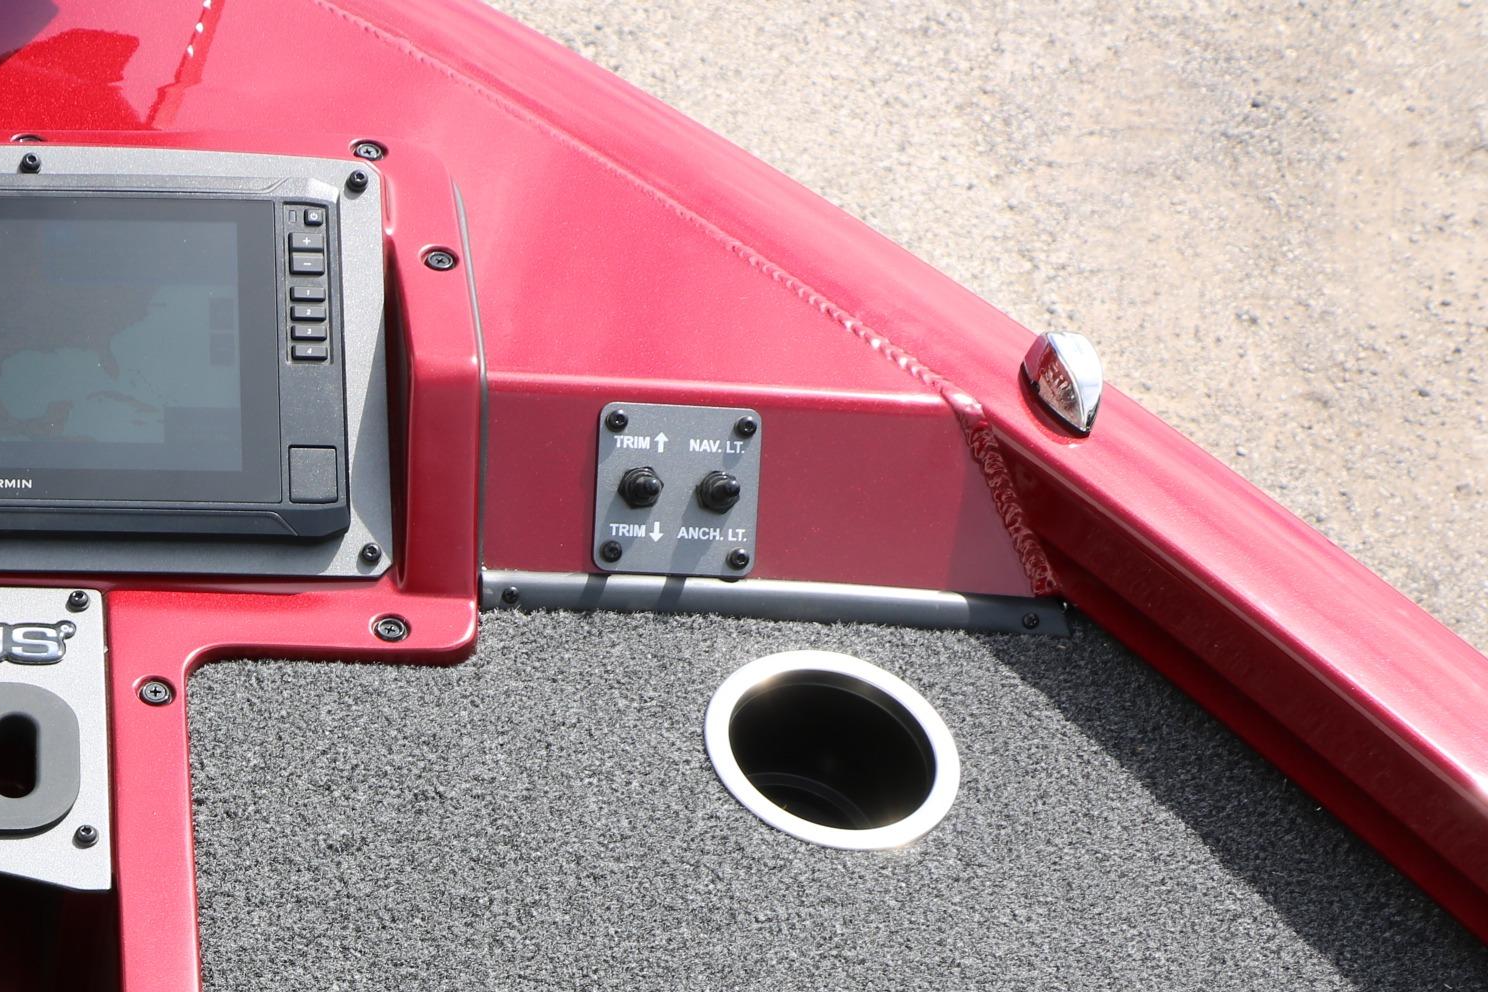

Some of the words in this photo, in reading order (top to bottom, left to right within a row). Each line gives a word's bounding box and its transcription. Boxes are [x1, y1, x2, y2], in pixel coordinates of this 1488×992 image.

[614, 435, 651, 450] TRIM
[689, 439, 722, 453] NAV.
[726, 441, 745, 454] LT.
[609, 523, 646, 537] TRIM
[677, 527, 724, 541] ANCH.
[728, 529, 748, 542] LT.
